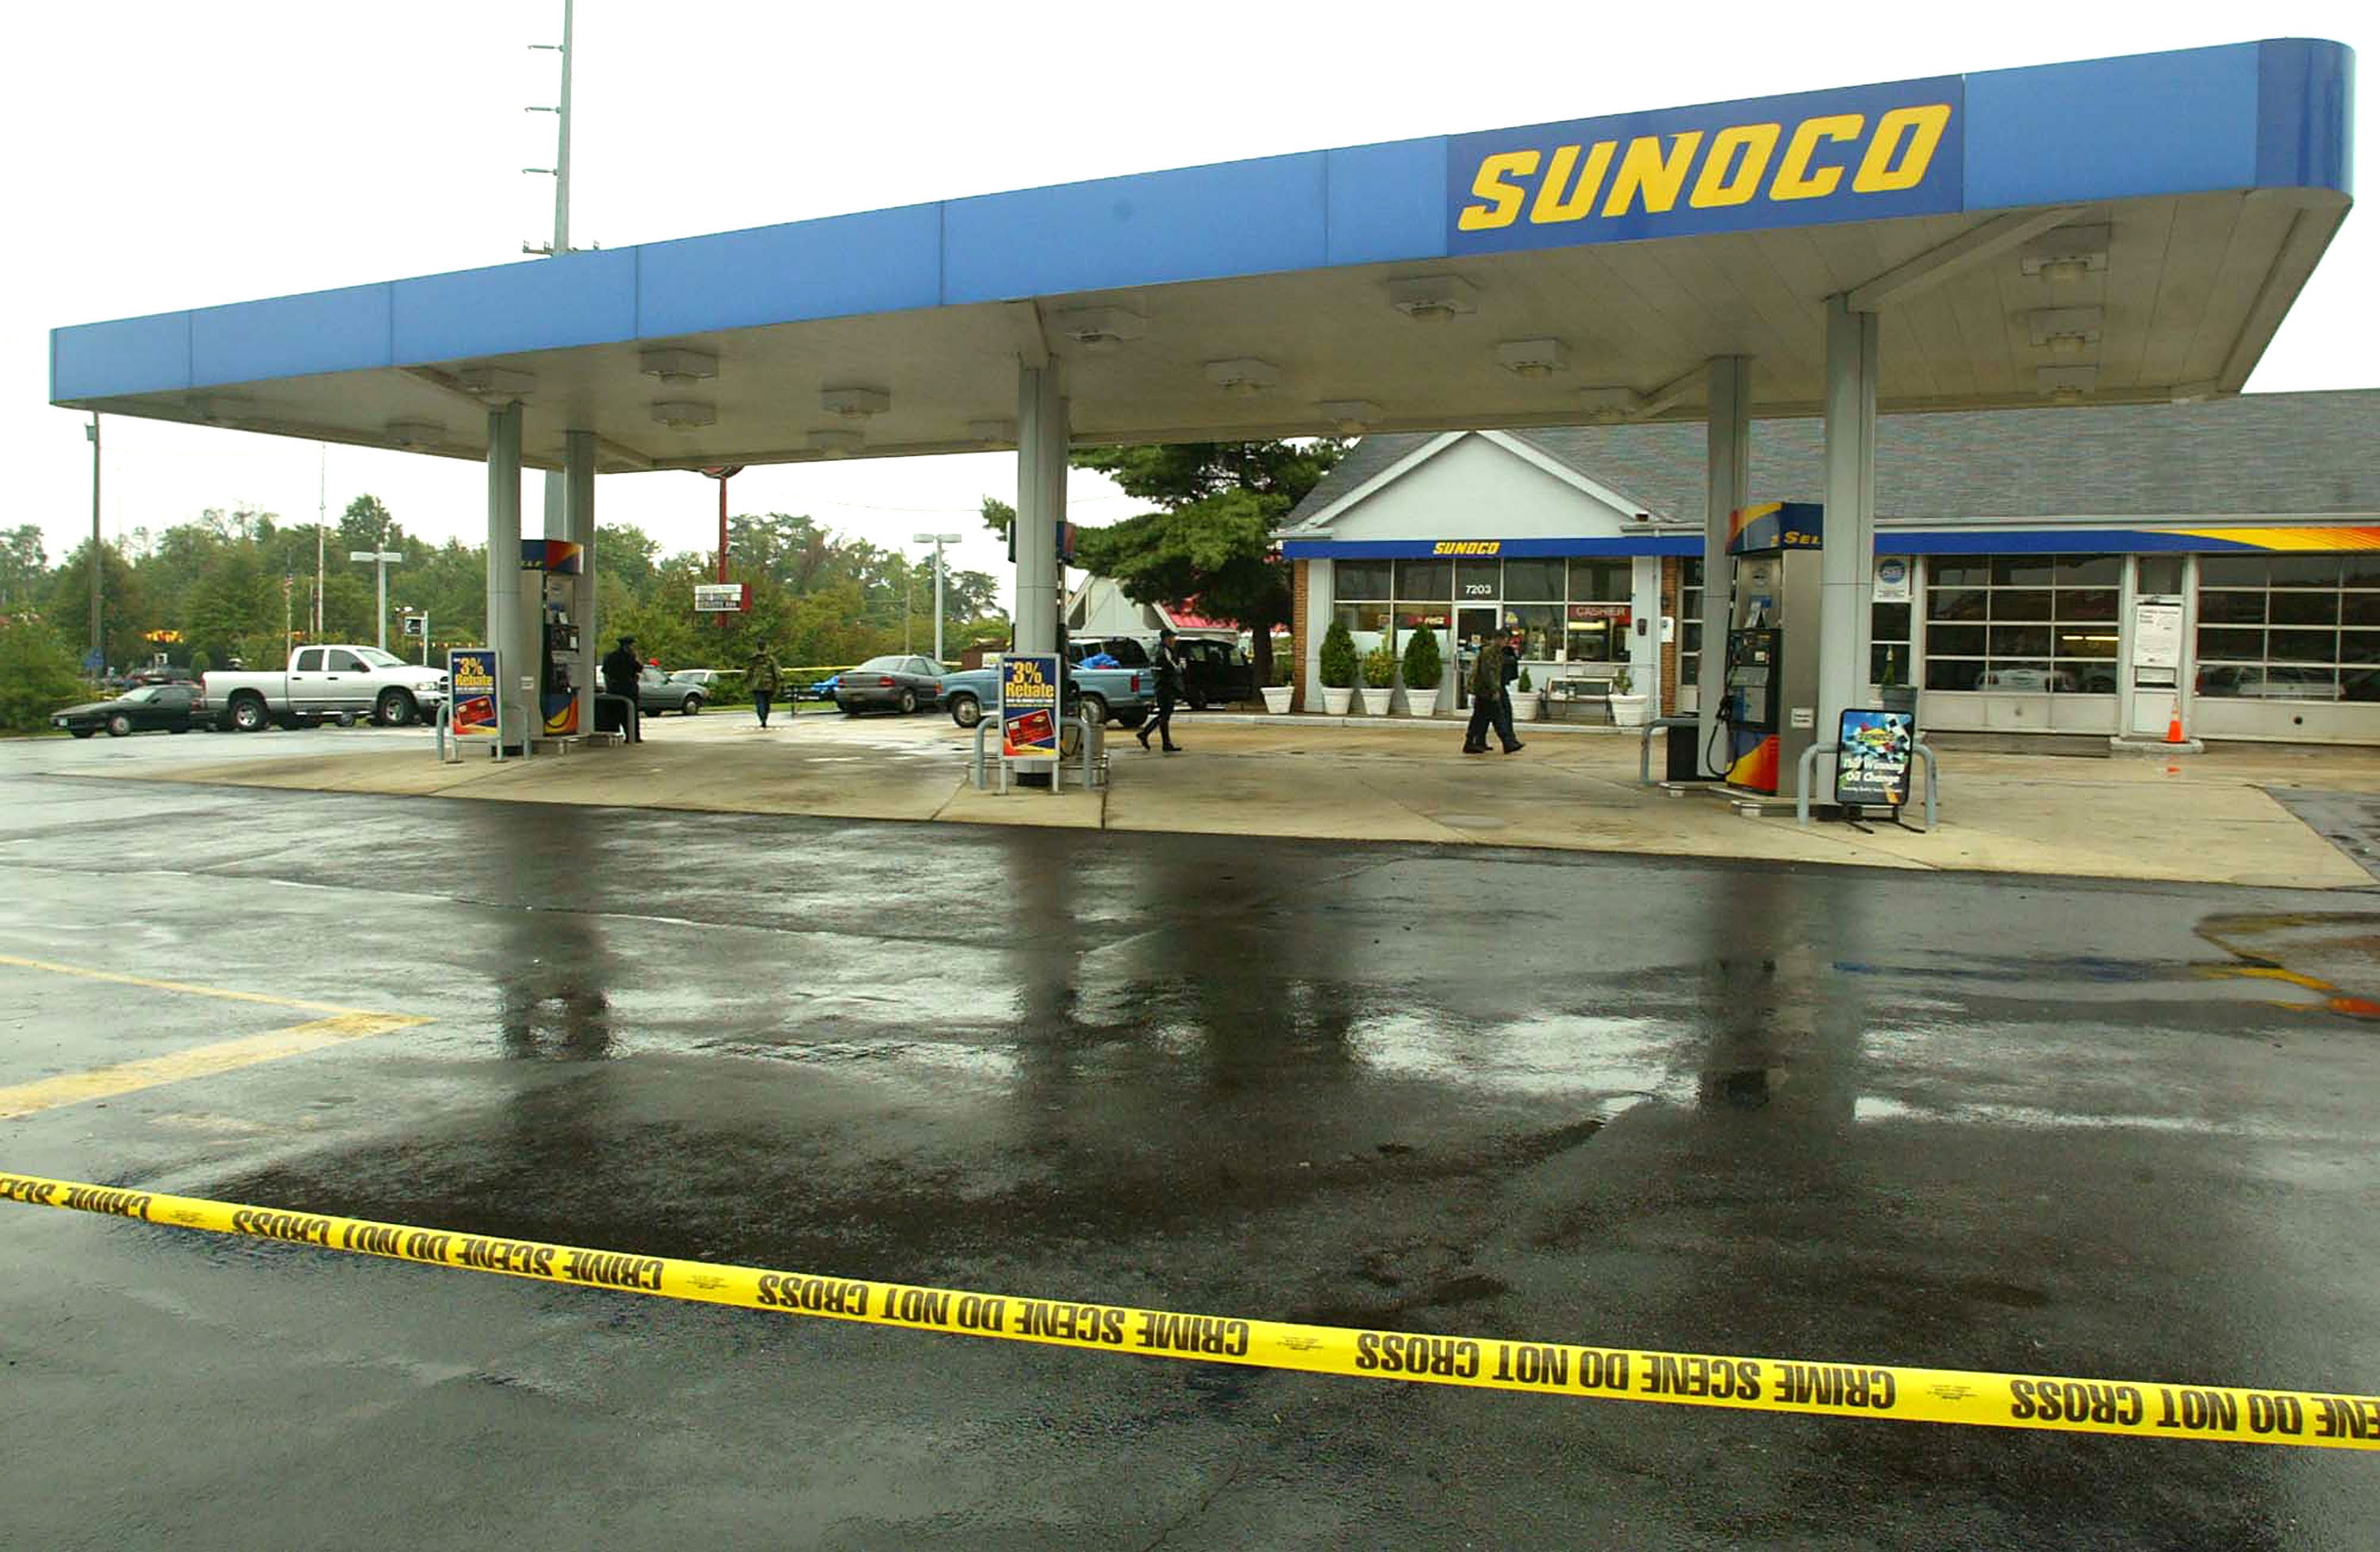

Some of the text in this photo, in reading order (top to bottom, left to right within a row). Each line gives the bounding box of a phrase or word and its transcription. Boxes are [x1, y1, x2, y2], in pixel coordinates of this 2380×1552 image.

[1457, 104, 1952, 231] SUNOCO
[1432, 542, 1501, 555] SUNOCO
[1465, 584, 1492, 594] 7203
[1006, 682, 1054, 697] Rebate
[1013, 661, 1042, 683] 3%
[232, 1210, 330, 1247] CROSS
[407, 1232, 451, 1262] DO
[456, 1238, 555, 1277] SCENE
[562, 1250, 664, 1290] CRIME
[757, 1275, 1248, 1356] CRIME SCENE DO NOT CROSS
[1357, 1333, 1896, 1409] CRIME SCENE DO NOT CROSS
[2010, 1379, 2143, 1426] CROSS
[2157, 1389, 2238, 1431] NOT
[2248, 1393, 2303, 1435] DO
